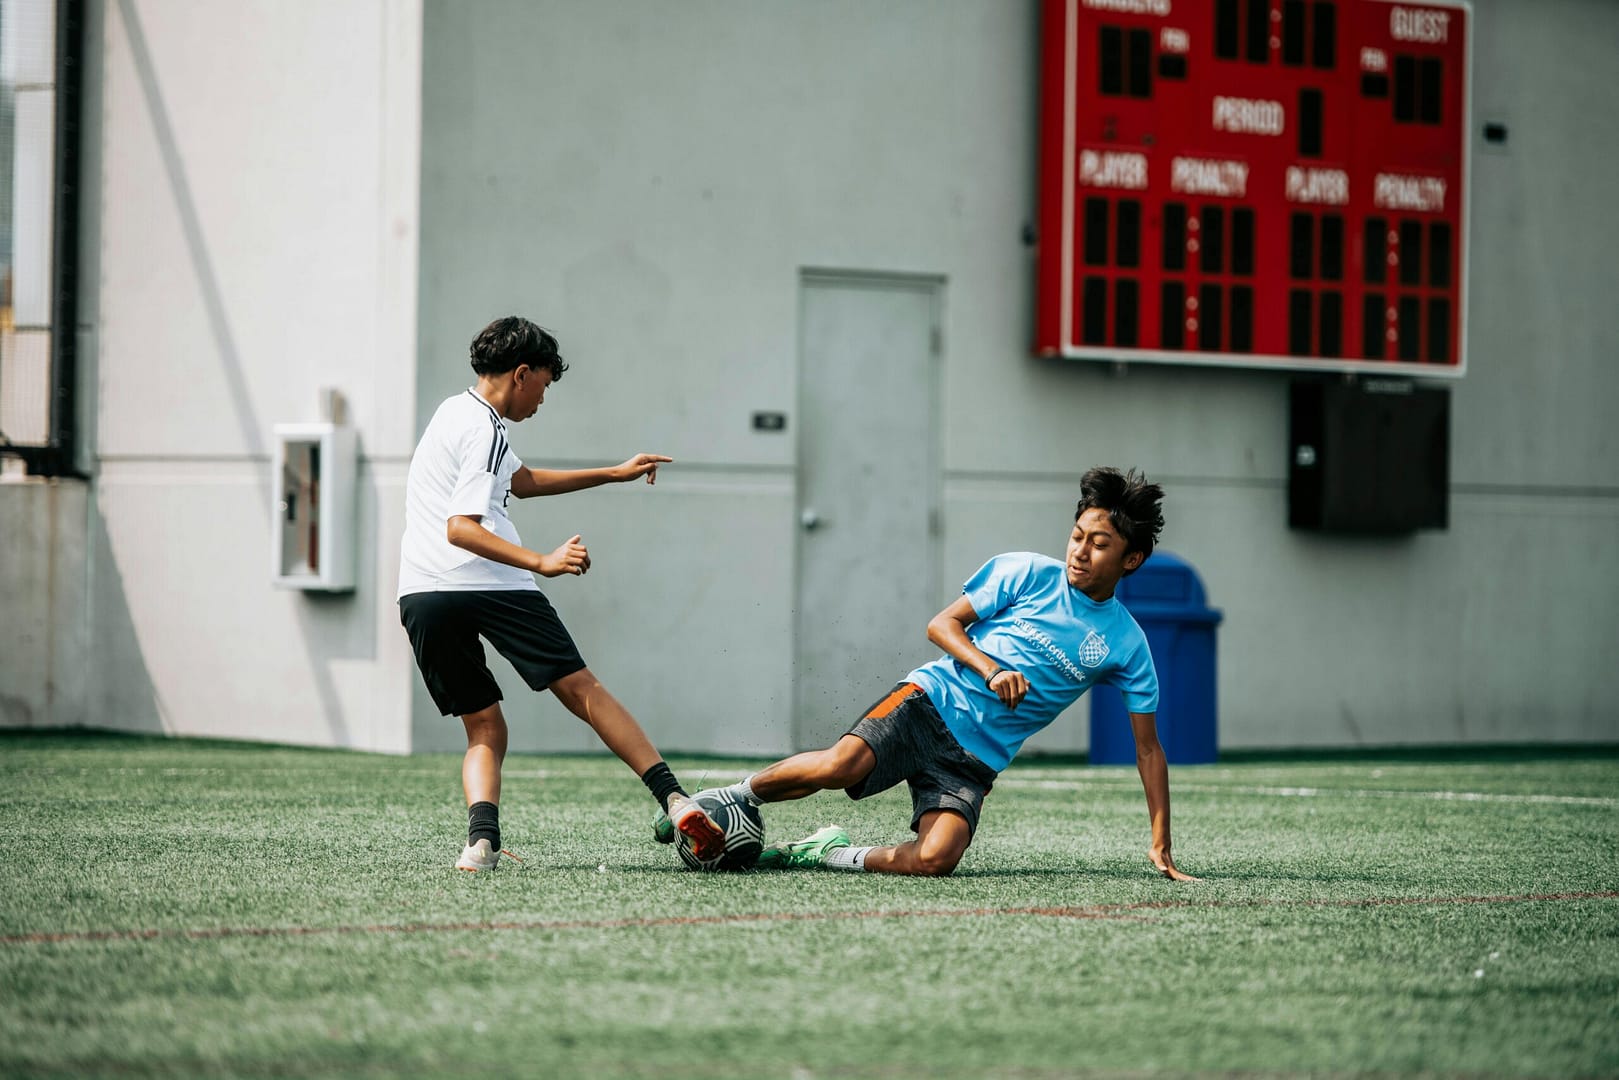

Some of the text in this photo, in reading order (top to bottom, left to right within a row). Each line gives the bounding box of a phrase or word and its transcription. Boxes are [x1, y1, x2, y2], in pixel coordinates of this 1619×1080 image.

[1390, 7, 1450, 43] GUEST
[1212, 96, 1285, 136] PERIOD
[1079, 149, 1250, 197] PLAYER PENALTY
[1285, 165, 1447, 212] PLAYER PENALTY
[1048, 644, 1086, 682] orthopedic
